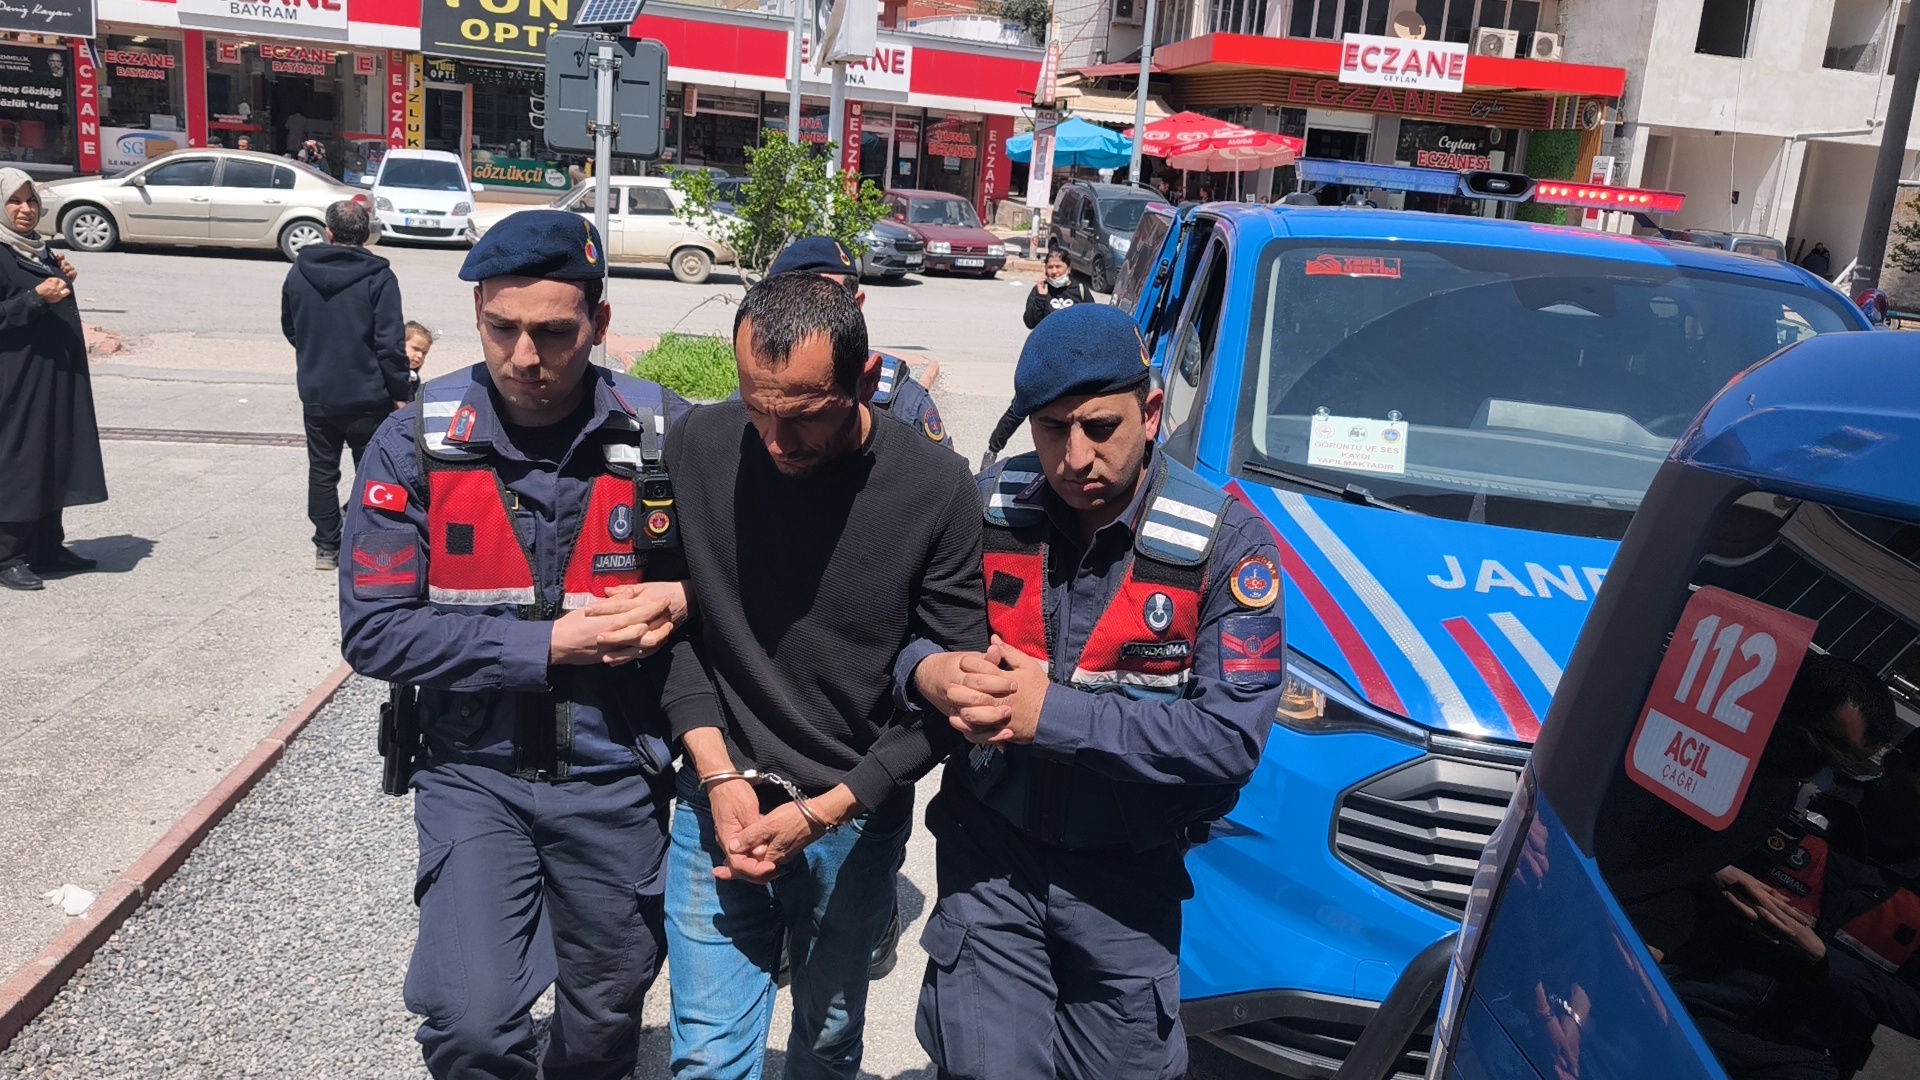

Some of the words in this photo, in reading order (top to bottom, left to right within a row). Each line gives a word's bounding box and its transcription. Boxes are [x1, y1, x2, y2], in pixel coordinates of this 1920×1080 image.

[230, 2, 298, 20] BAYRAM
[105, 50, 175, 68] ECZANE
[260, 43, 336, 64] ECZANE
[1343, 43, 1465, 80] ECZANE
[116, 66, 165, 79] BAYRAM
[272, 61, 325, 75] BAYRAM
[1384, 74, 1418, 84] CEYLAN
[0, 84, 19, 95] neş
[21, 86, 62, 98] Gözlüğü
[79, 44, 96, 154] ECZANE
[1288, 76, 1456, 116] ECZANE
[35, 101, 59, 110] Lens
[391, 74, 404, 150] ECZA
[123, 141, 144, 154] SG
[1438, 135, 1477, 152] Ceylan
[846, 117, 859, 195] ECZAN
[473, 164, 543, 183] GÖZLÜKÇÜ
[1314, 441, 1362, 451] GÖRÜNTÜ
[1317, 457, 1395, 470] YAPILMAKTADIR
[1341, 452, 1371, 460] KAYDI
[1673, 614, 1778, 734] 112
[1664, 730, 1711, 779] ACİL
[1661, 764, 1698, 794] ÇAĞRI
